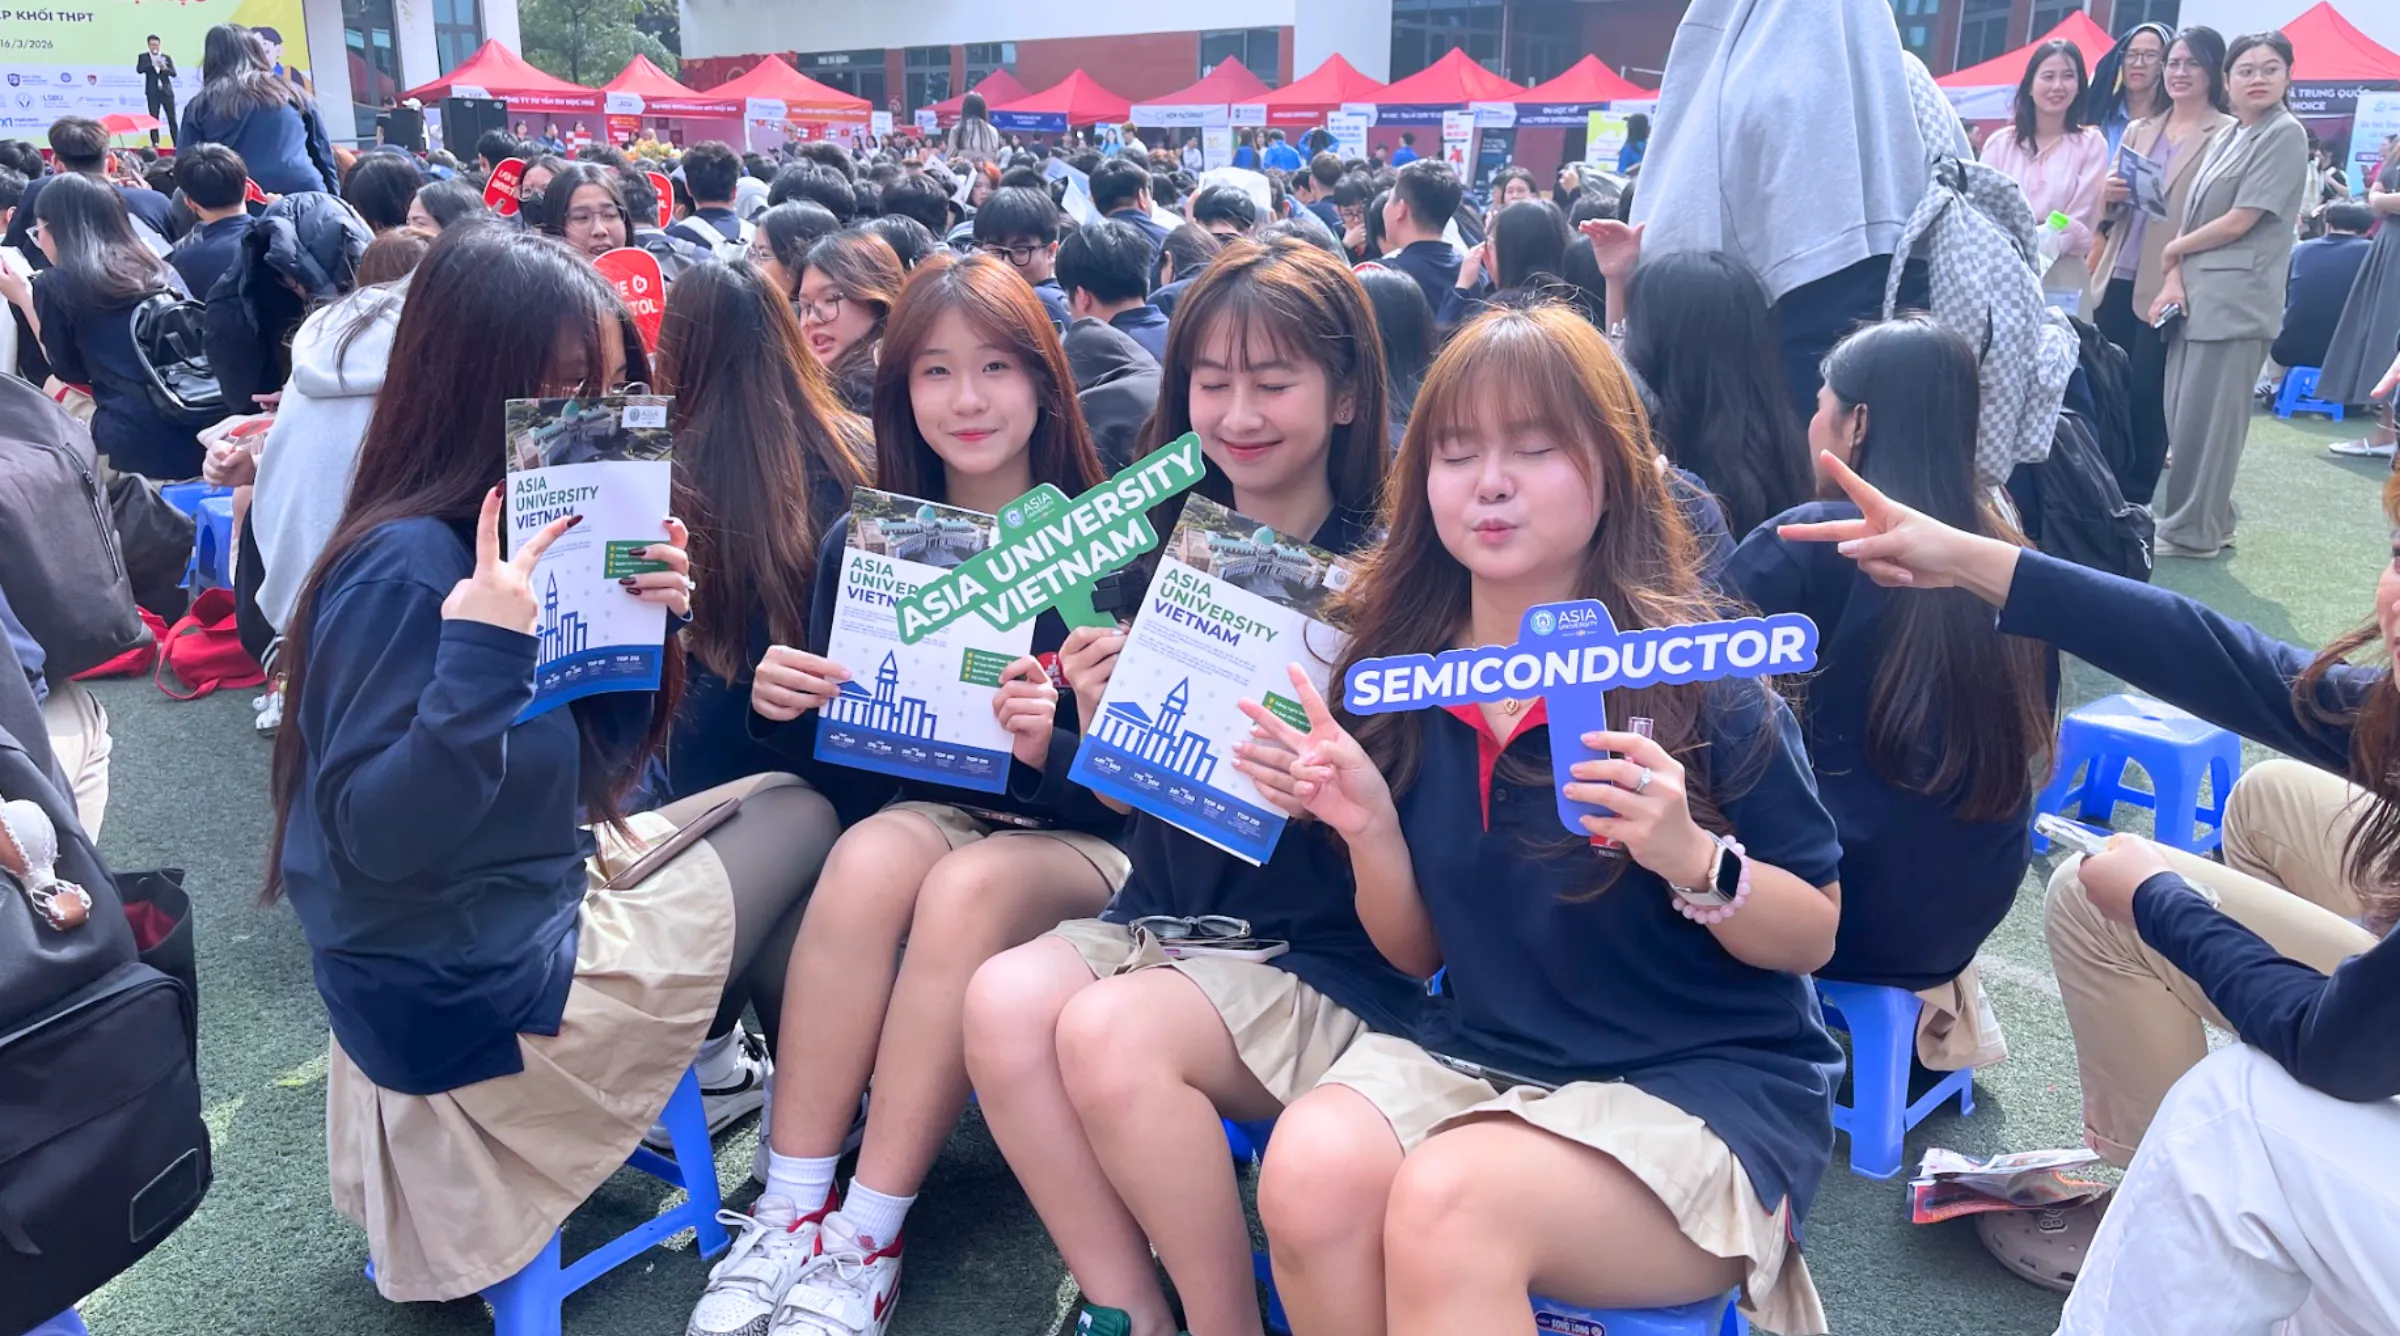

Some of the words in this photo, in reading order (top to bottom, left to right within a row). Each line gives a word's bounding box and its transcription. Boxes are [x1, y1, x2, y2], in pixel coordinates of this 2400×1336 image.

[0, 10, 11, 19] P
[16, 8, 53, 21] KHỐI
[57, 12, 94, 22] THPT
[2299, 88, 2336, 98] TRUNG
[2291, 101, 2327, 111] HOICE
[515, 476, 547, 494] ASIA
[516, 485, 600, 512] UNIVERSITY
[1023, 492, 1053, 514] ASIA
[516, 505, 575, 530] VIETNAM
[902, 573, 988, 638] ASIA
[985, 443, 1196, 583] UNIVERSITY
[850, 556, 894, 577] ASIA
[982, 518, 1148, 625] VIETNAM
[849, 570, 919, 596] UNIVER
[1164, 568, 1212, 598] ASIA
[847, 585, 900, 610] VIETN
[1155, 598, 1241, 647] VIETNAM
[1160, 582, 1279, 643] UNIVERSITY
[1558, 608, 1598, 624] ASIA
[1352, 625, 1806, 706] SEMICONDUCTOR
